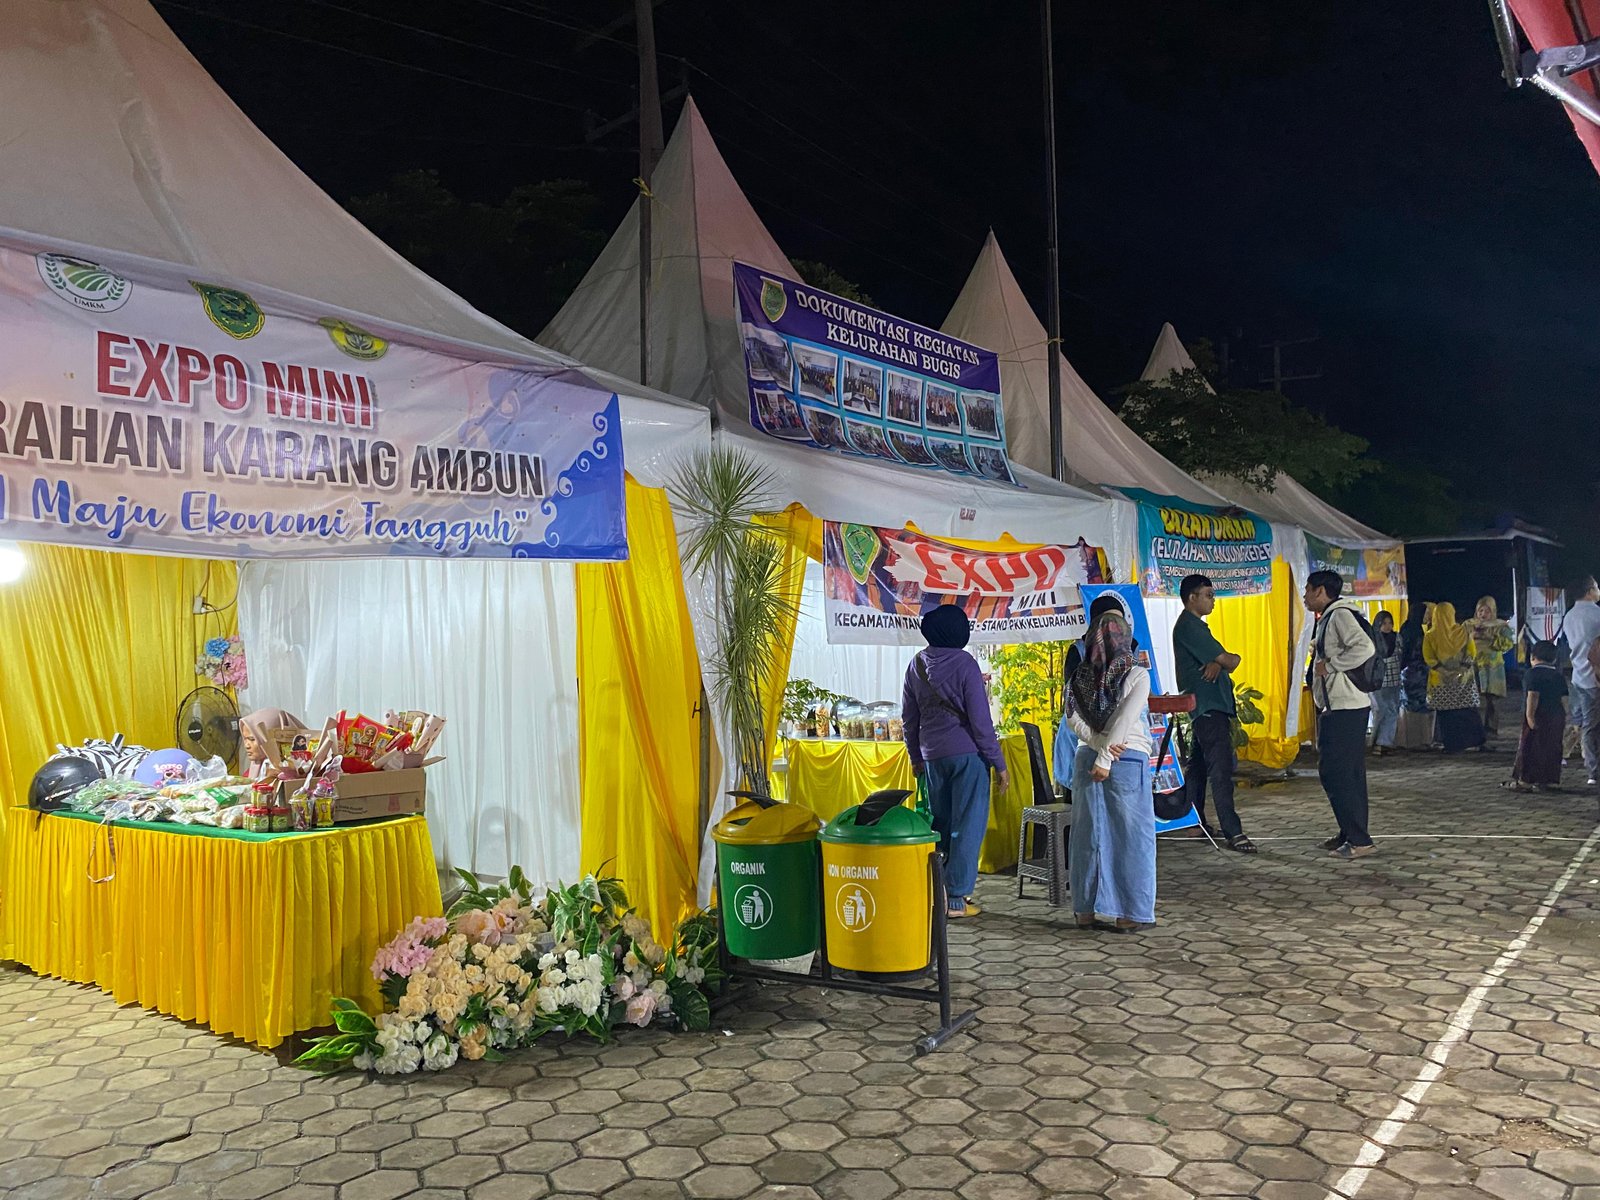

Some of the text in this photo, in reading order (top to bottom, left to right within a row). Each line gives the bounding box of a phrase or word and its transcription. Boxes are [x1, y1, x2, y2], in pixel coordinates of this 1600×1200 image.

[74, 297, 105, 310] UMKM
[795, 289, 979, 366] DOKUMENTASI KEGIATAN
[827, 322, 961, 380] KELURAHAN BUGIS
[97, 330, 373, 427] EXPO MINI
[203, 421, 399, 490] KARANG
[410, 445, 544, 497] AMBUN
[32, 478, 167, 539] Maju
[181, 491, 350, 537] Ekonomi
[915, 545, 1066, 592] EXPO
[1016, 591, 1057, 610] MINI
[835, 613, 902, 629] KECAMATAN
[981, 620, 1007, 631] STAND
[1028, 615, 1078, 629] KELURAHAN
[730, 861, 765, 875] ORGANIK
[840, 865, 879, 880] ORGANIK
